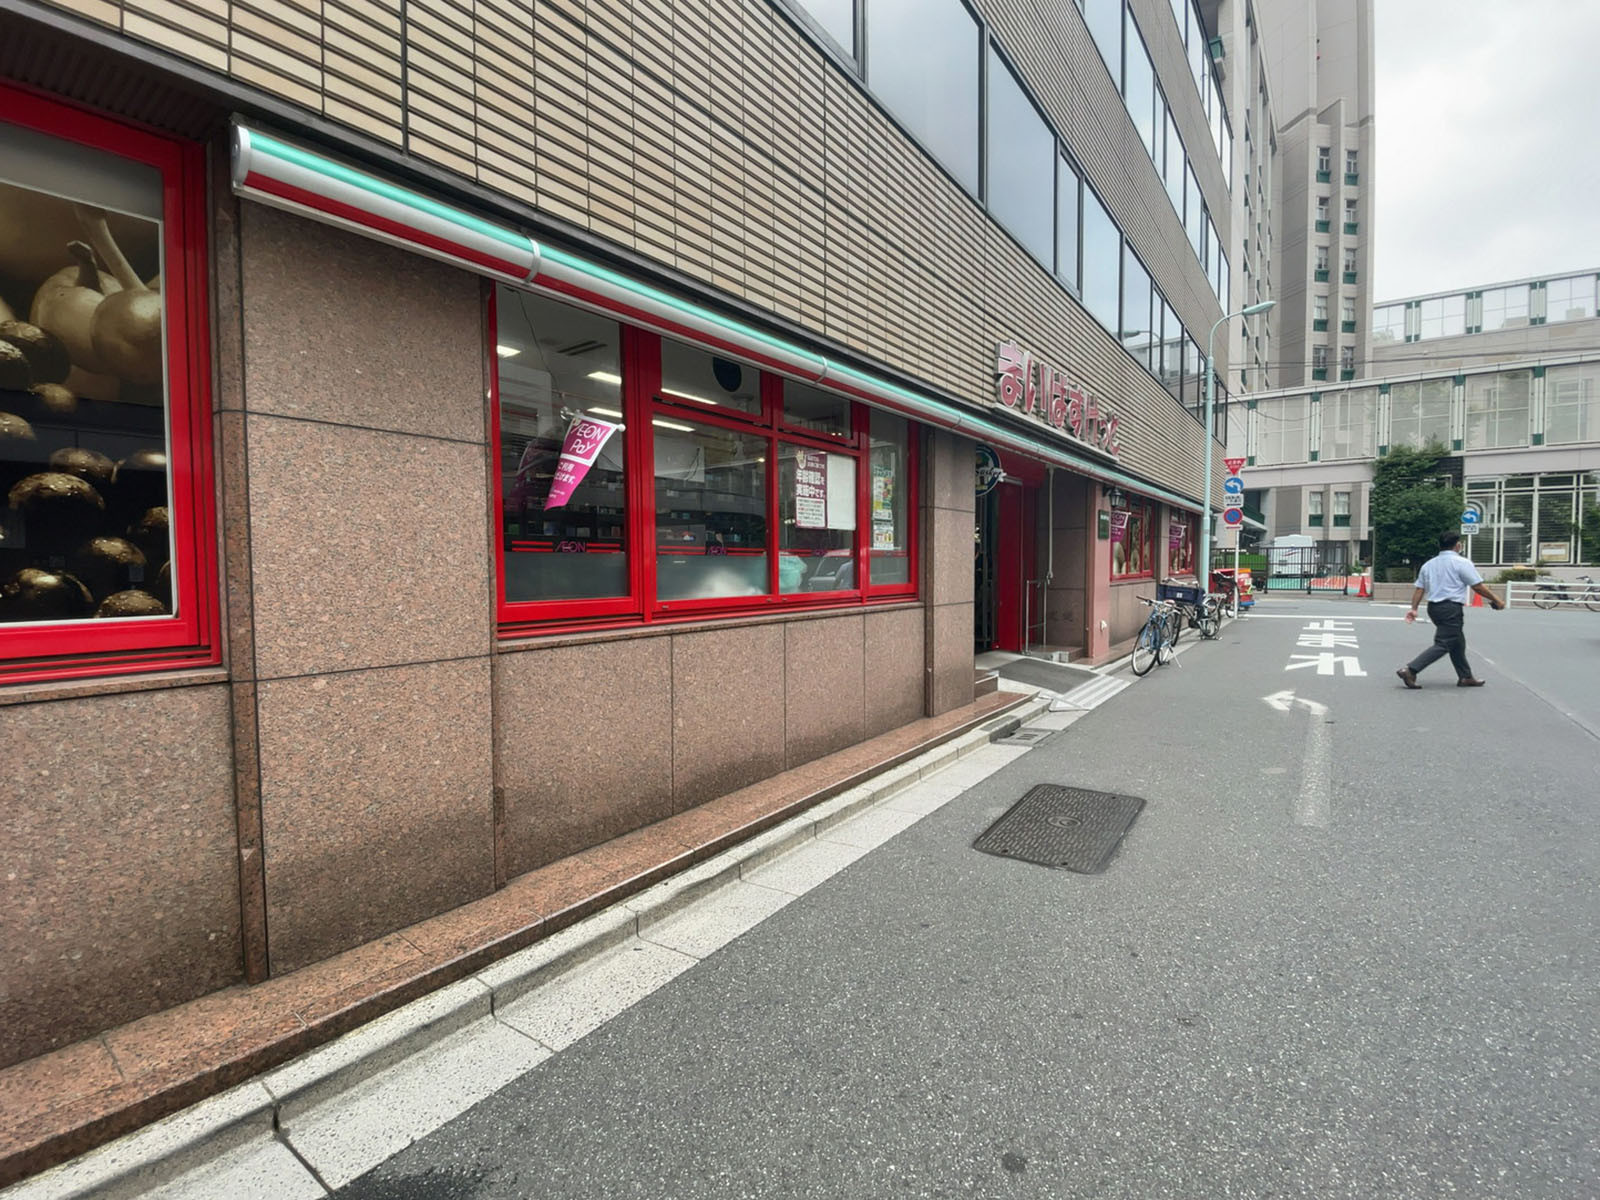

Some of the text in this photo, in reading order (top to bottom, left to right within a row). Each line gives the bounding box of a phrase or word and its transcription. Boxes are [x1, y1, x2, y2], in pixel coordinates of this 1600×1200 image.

[995, 340, 1120, 456] まいばすけっと
[1284, 619, 1368, 677] 止まれ
